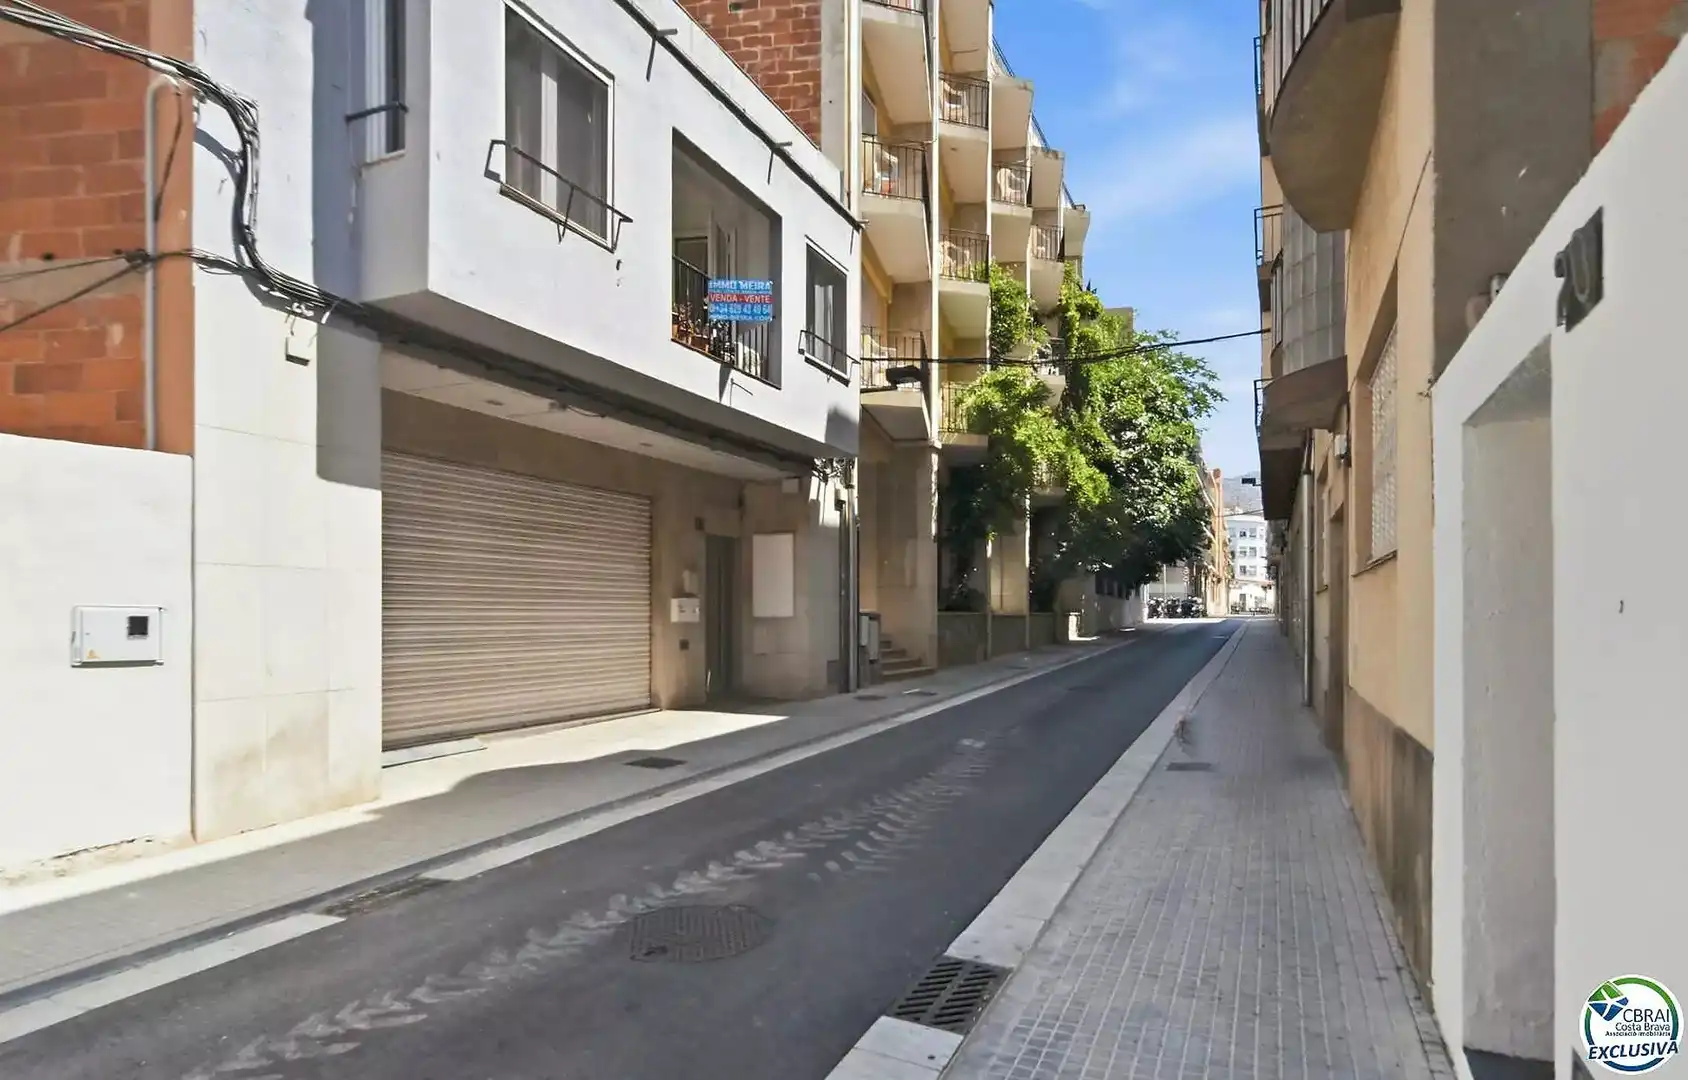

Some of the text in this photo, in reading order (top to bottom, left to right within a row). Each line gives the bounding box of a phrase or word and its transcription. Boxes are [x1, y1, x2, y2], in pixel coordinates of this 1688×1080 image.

[739, 280, 770, 290] MEIRA
[710, 294, 738, 303] VENDA
[744, 294, 770, 303] VENTE
